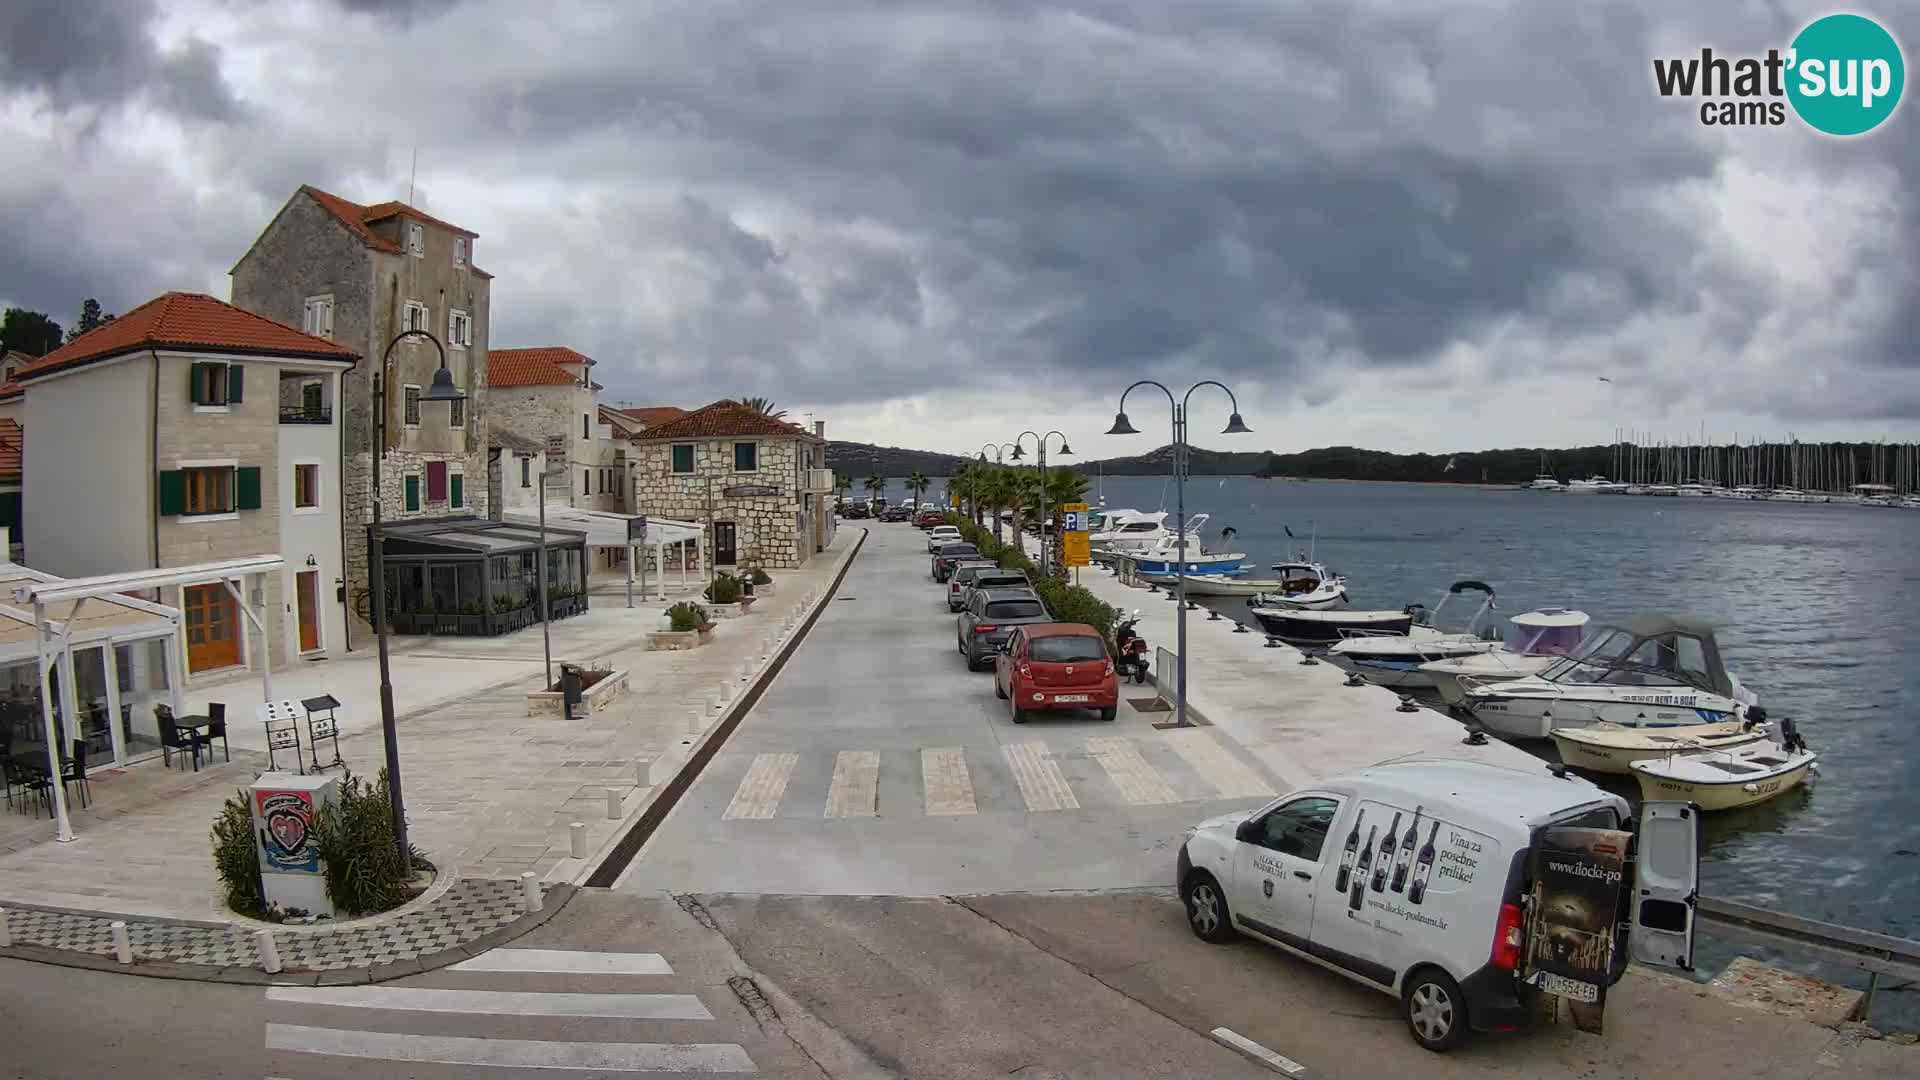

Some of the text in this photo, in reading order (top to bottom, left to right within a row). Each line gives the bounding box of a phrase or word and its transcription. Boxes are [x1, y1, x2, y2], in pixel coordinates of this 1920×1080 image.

[1066, 513, 1076, 529] P
[1655, 695, 1673, 705] RENT
[1680, 695, 1697, 706] BOAT
[1450, 831, 1470, 849] Vina
[1440, 850, 1478, 868] posebne
